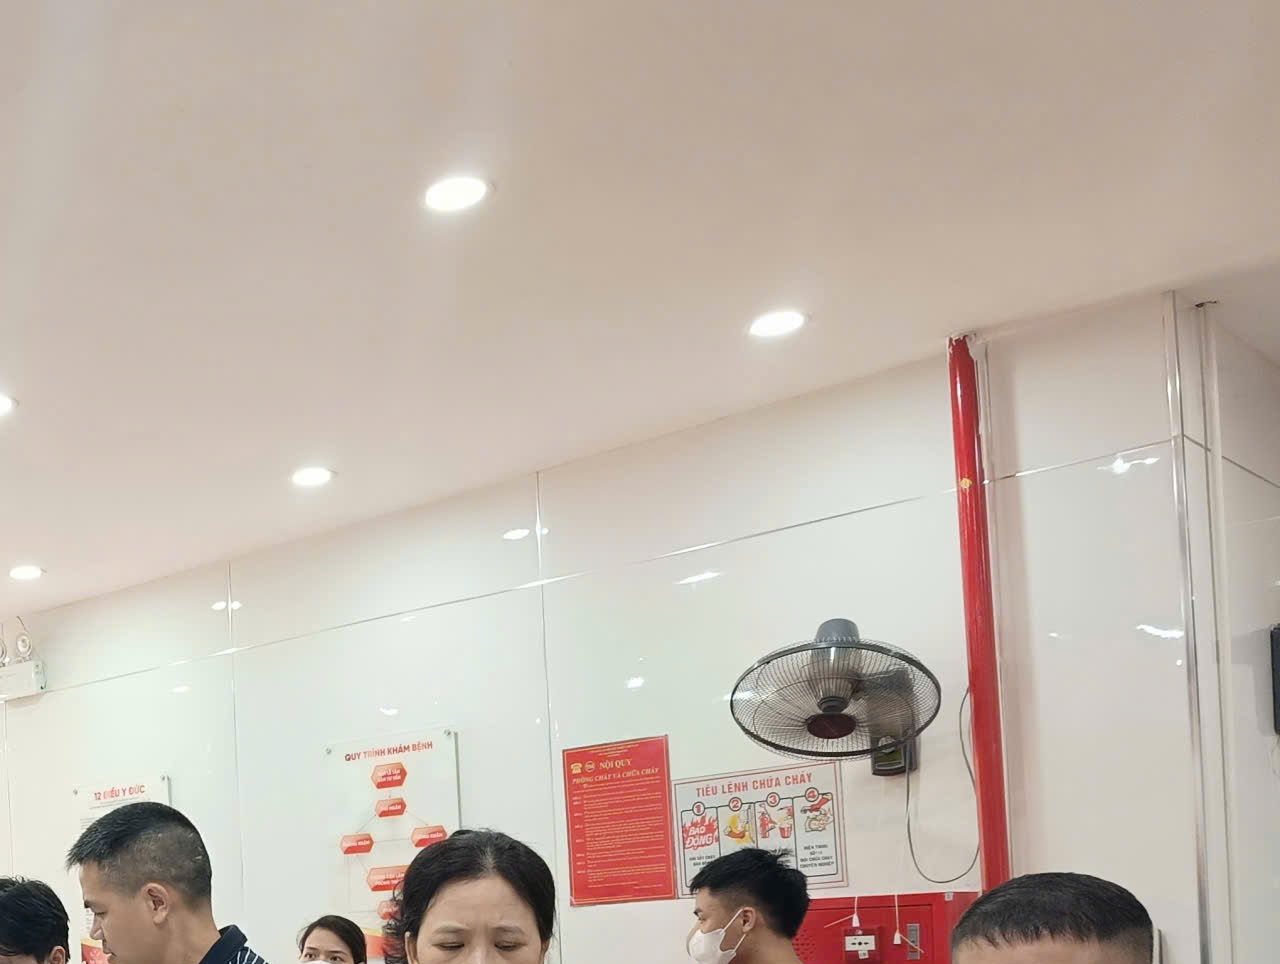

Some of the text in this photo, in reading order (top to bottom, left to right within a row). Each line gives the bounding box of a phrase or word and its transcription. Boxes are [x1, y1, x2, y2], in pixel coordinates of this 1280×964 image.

[344, 751, 362, 762] QUY
[387, 743, 410, 756] KHÁM
[411, 741, 433, 753] BỆNH
[599, 759, 632, 770] NỘI QUY
[696, 783, 718, 797] TIÊU
[721, 779, 749, 795] LỆNH
[784, 771, 813, 786] CHÁY
[94, 792, 101, 801] 12
[122, 788, 127, 797] Y
[770, 795, 777, 804] 3
[807, 790, 816, 799] 4
[695, 804, 701, 814] 1
[732, 799, 739, 809] 2
